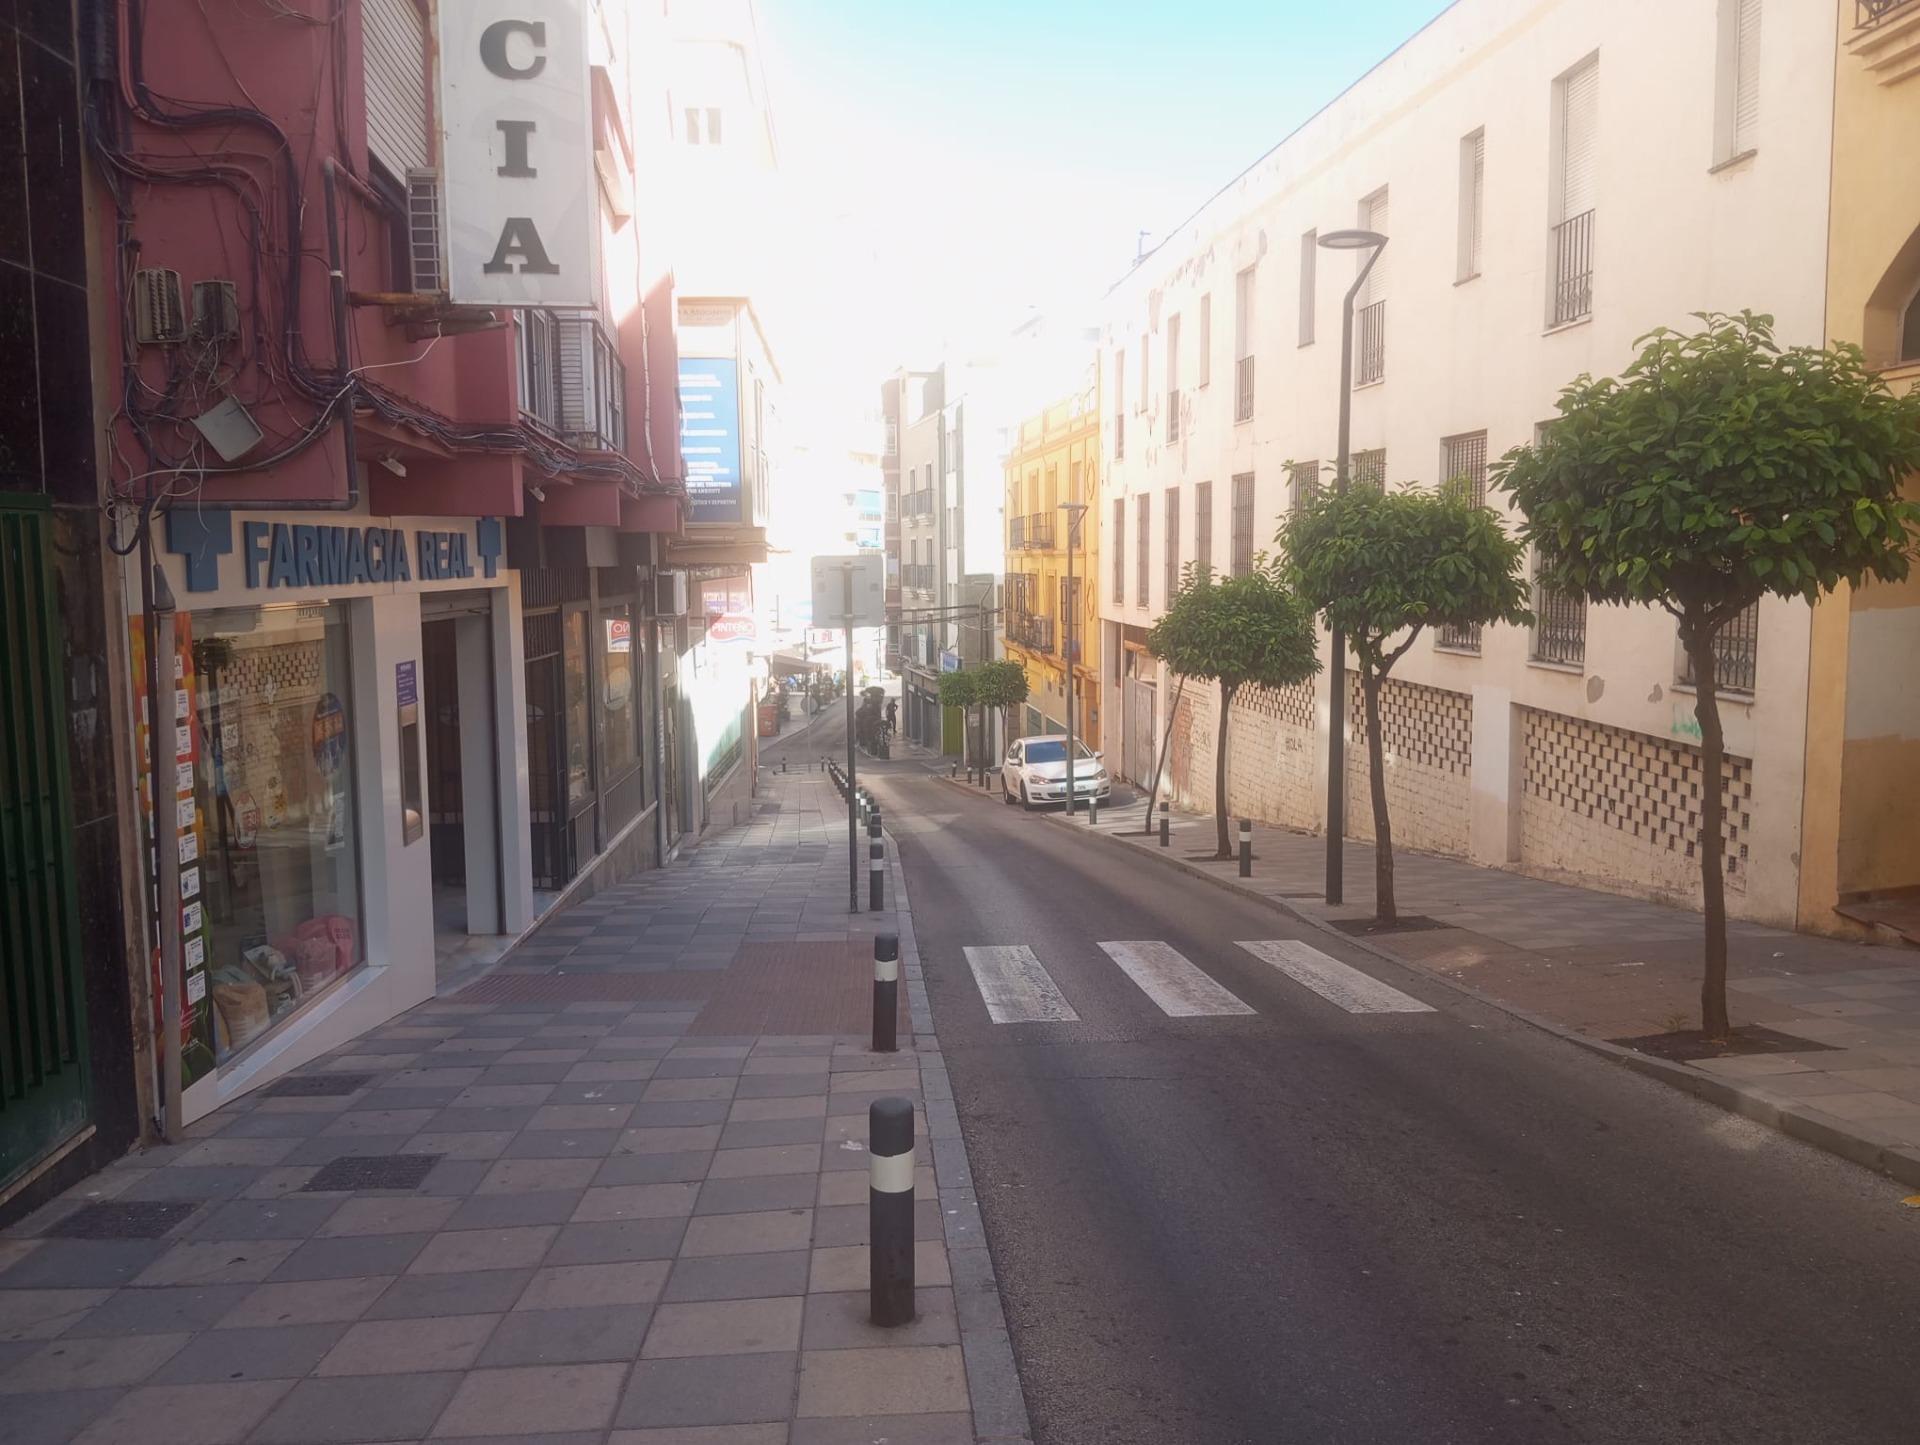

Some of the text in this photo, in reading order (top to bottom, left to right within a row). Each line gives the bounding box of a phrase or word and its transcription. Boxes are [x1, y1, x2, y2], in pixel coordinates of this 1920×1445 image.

[479, 19, 560, 275] CIA
[244, 520, 474, 589] FARMACIA REAL
